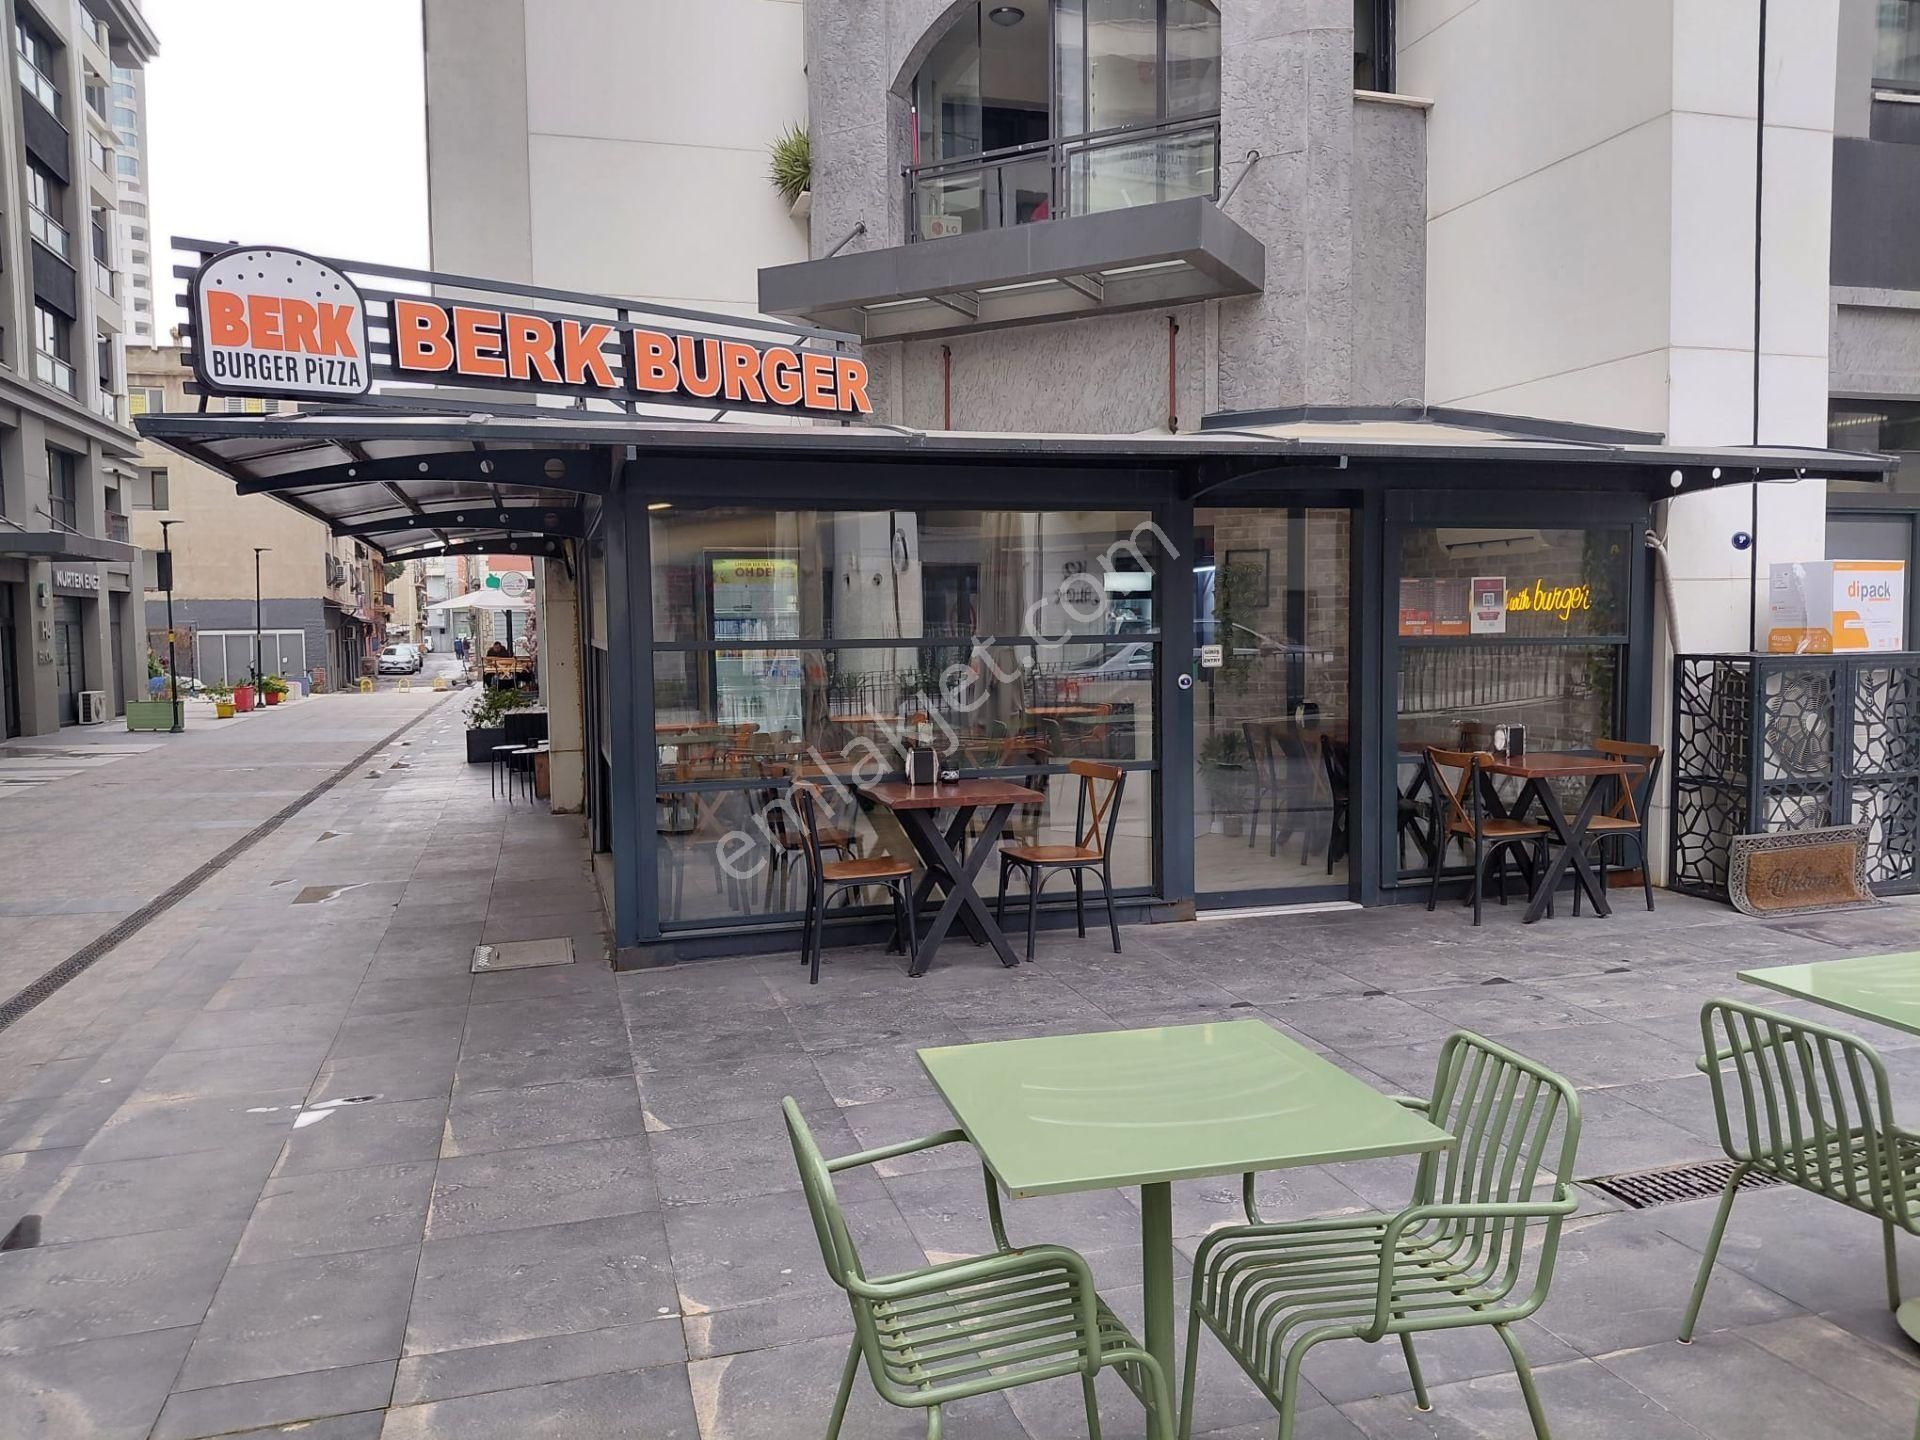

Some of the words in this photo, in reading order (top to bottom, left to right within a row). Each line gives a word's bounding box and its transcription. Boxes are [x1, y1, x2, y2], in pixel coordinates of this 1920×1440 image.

[206, 290, 358, 358] BERK
[213, 350, 299, 383] BURGER
[395, 298, 620, 389] BERK
[633, 328, 874, 414] BURGER
[1847, 580, 1891, 602] dipack
